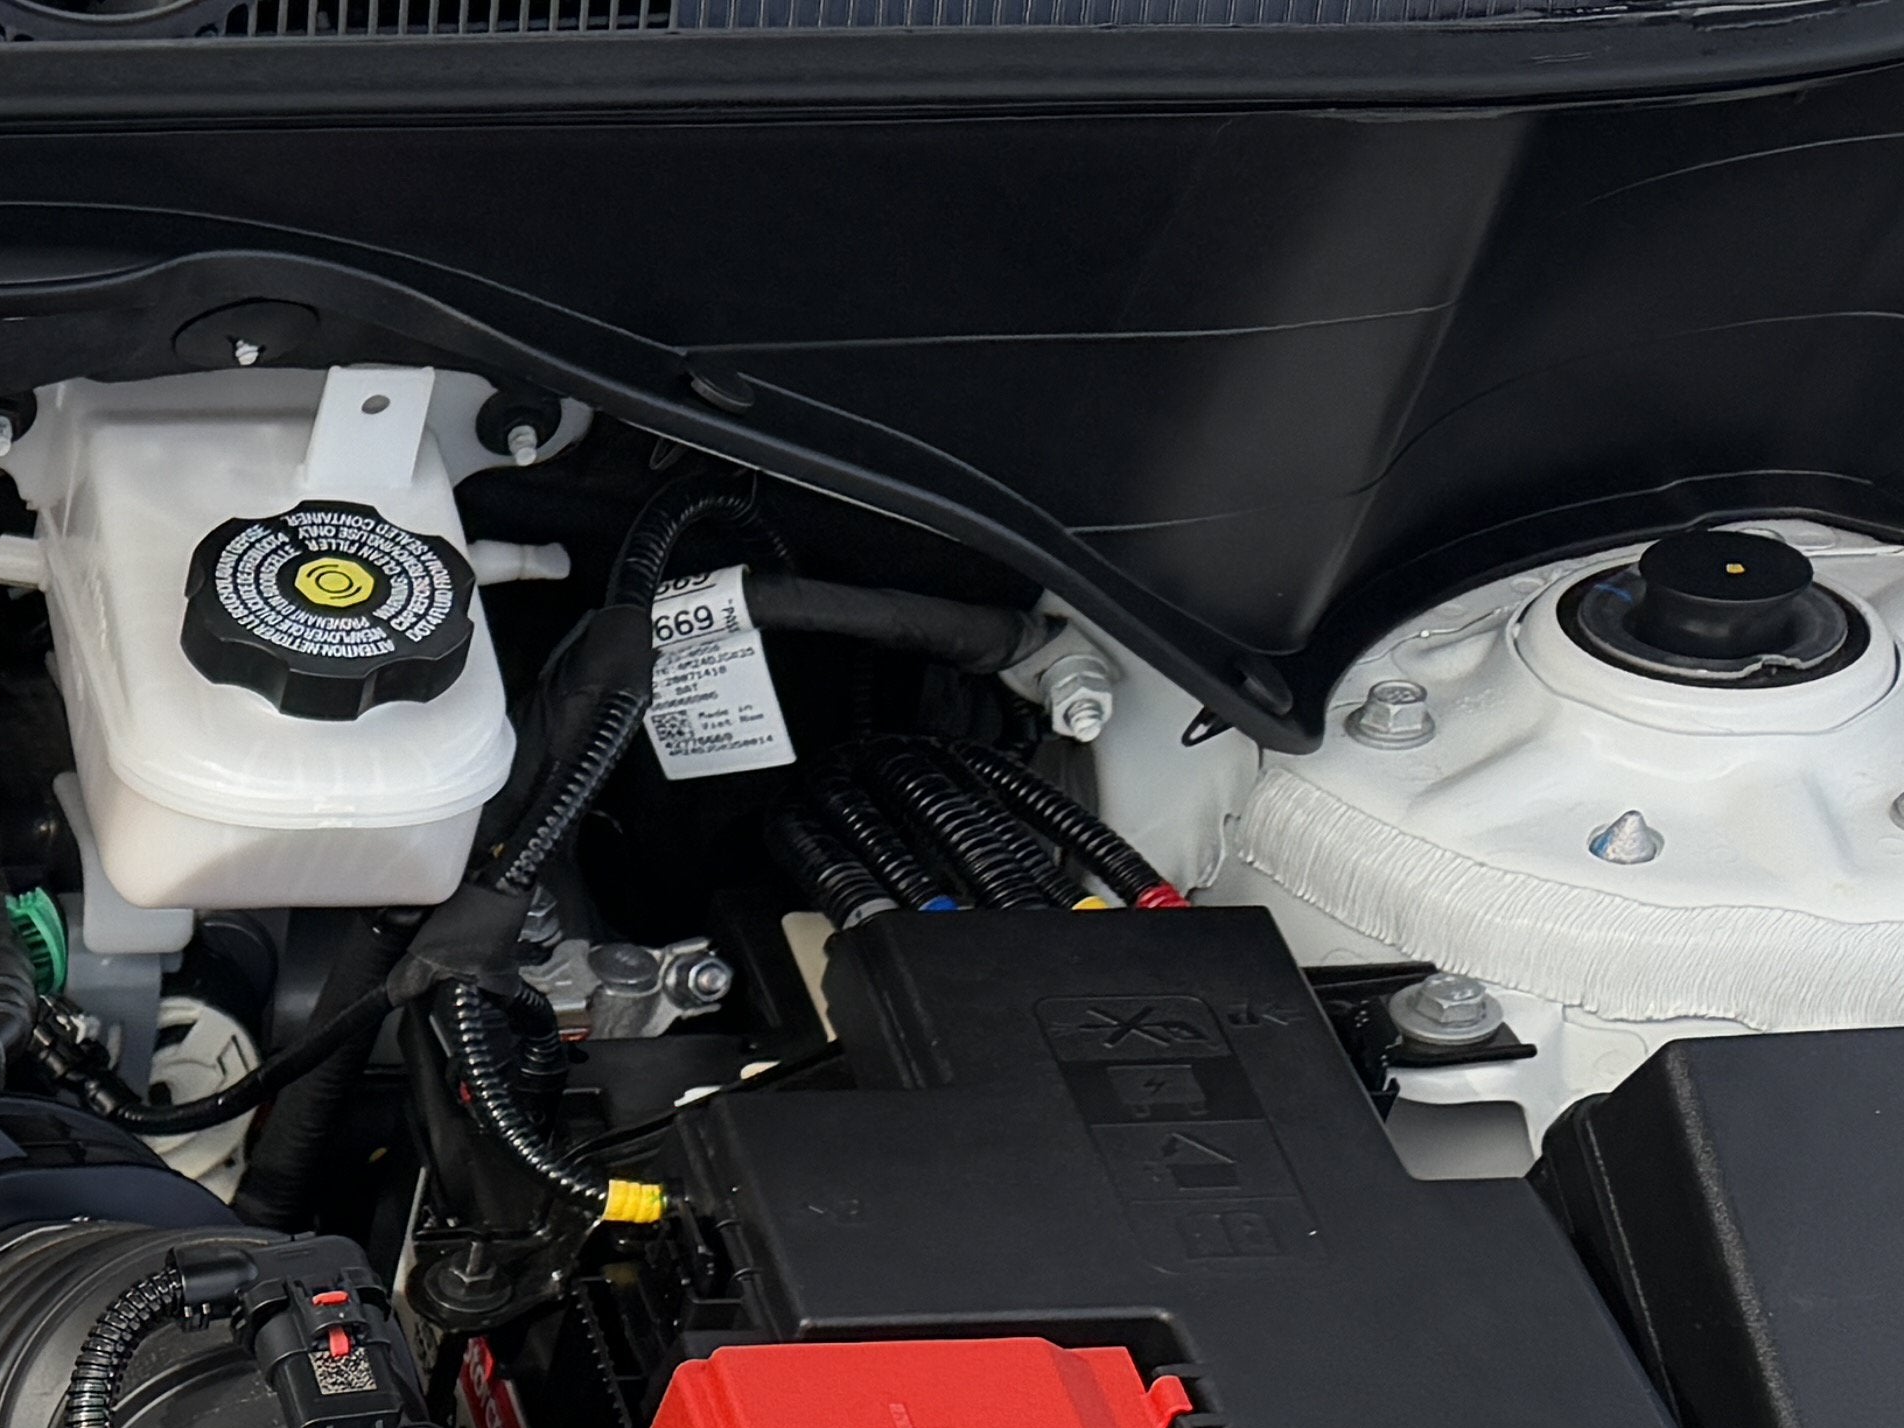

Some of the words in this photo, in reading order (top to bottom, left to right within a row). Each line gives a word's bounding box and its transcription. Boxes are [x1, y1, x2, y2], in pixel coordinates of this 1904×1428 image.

[298, 525, 336, 540] ONLY
[339, 527, 367, 542] USE
[376, 523, 428, 555] SEALED
[305, 539, 359, 553] FILLER
[358, 545, 401, 575] CLEAN
[407, 576, 432, 614] BEFORE
[290, 609, 370, 631] PROVENANT
[253, 623, 321, 655] NETTOYER
